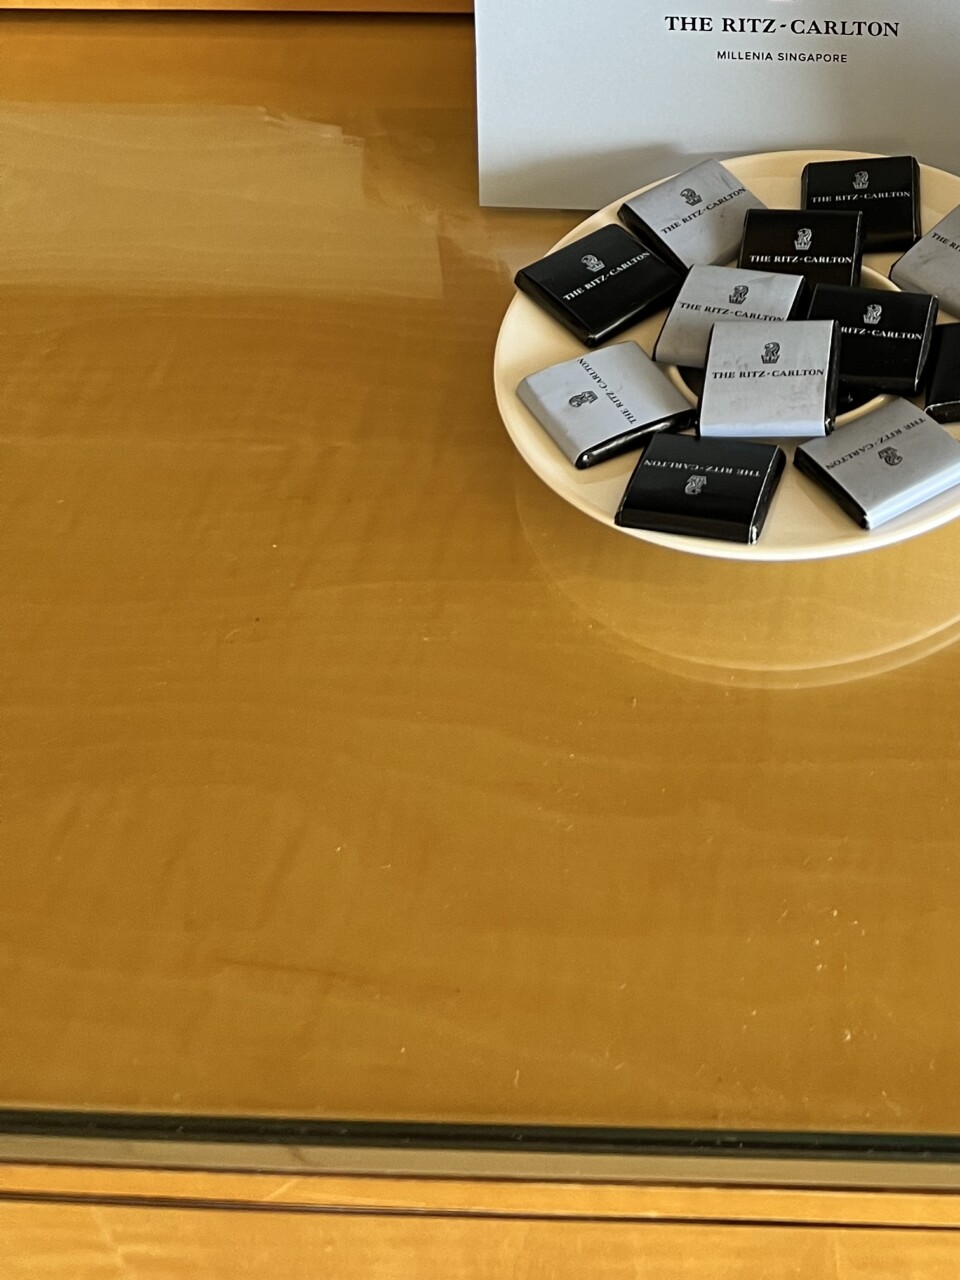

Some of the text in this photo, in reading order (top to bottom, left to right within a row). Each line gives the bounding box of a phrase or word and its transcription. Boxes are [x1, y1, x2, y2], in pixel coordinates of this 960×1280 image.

[664, 16, 899, 37] THE RITZ-CARLTON
[716, 51, 848, 63] MILLENIA SINGAPORE
[811, 190, 911, 204] THE RITZ-CARLTON
[661, 186, 747, 234] THE RITZ-CARLTON
[931, 232, 949, 245] THE
[750, 255, 853, 264] THE RITZ-CARLTON
[563, 251, 651, 301] THE RITZ-CARLTON
[679, 302, 702, 311] THE
[712, 368, 825, 379] THE RITZ-CARLTON
[621, 408, 637, 424] THE
[903, 417, 927, 432] THE
[736, 469, 761, 477] THE
